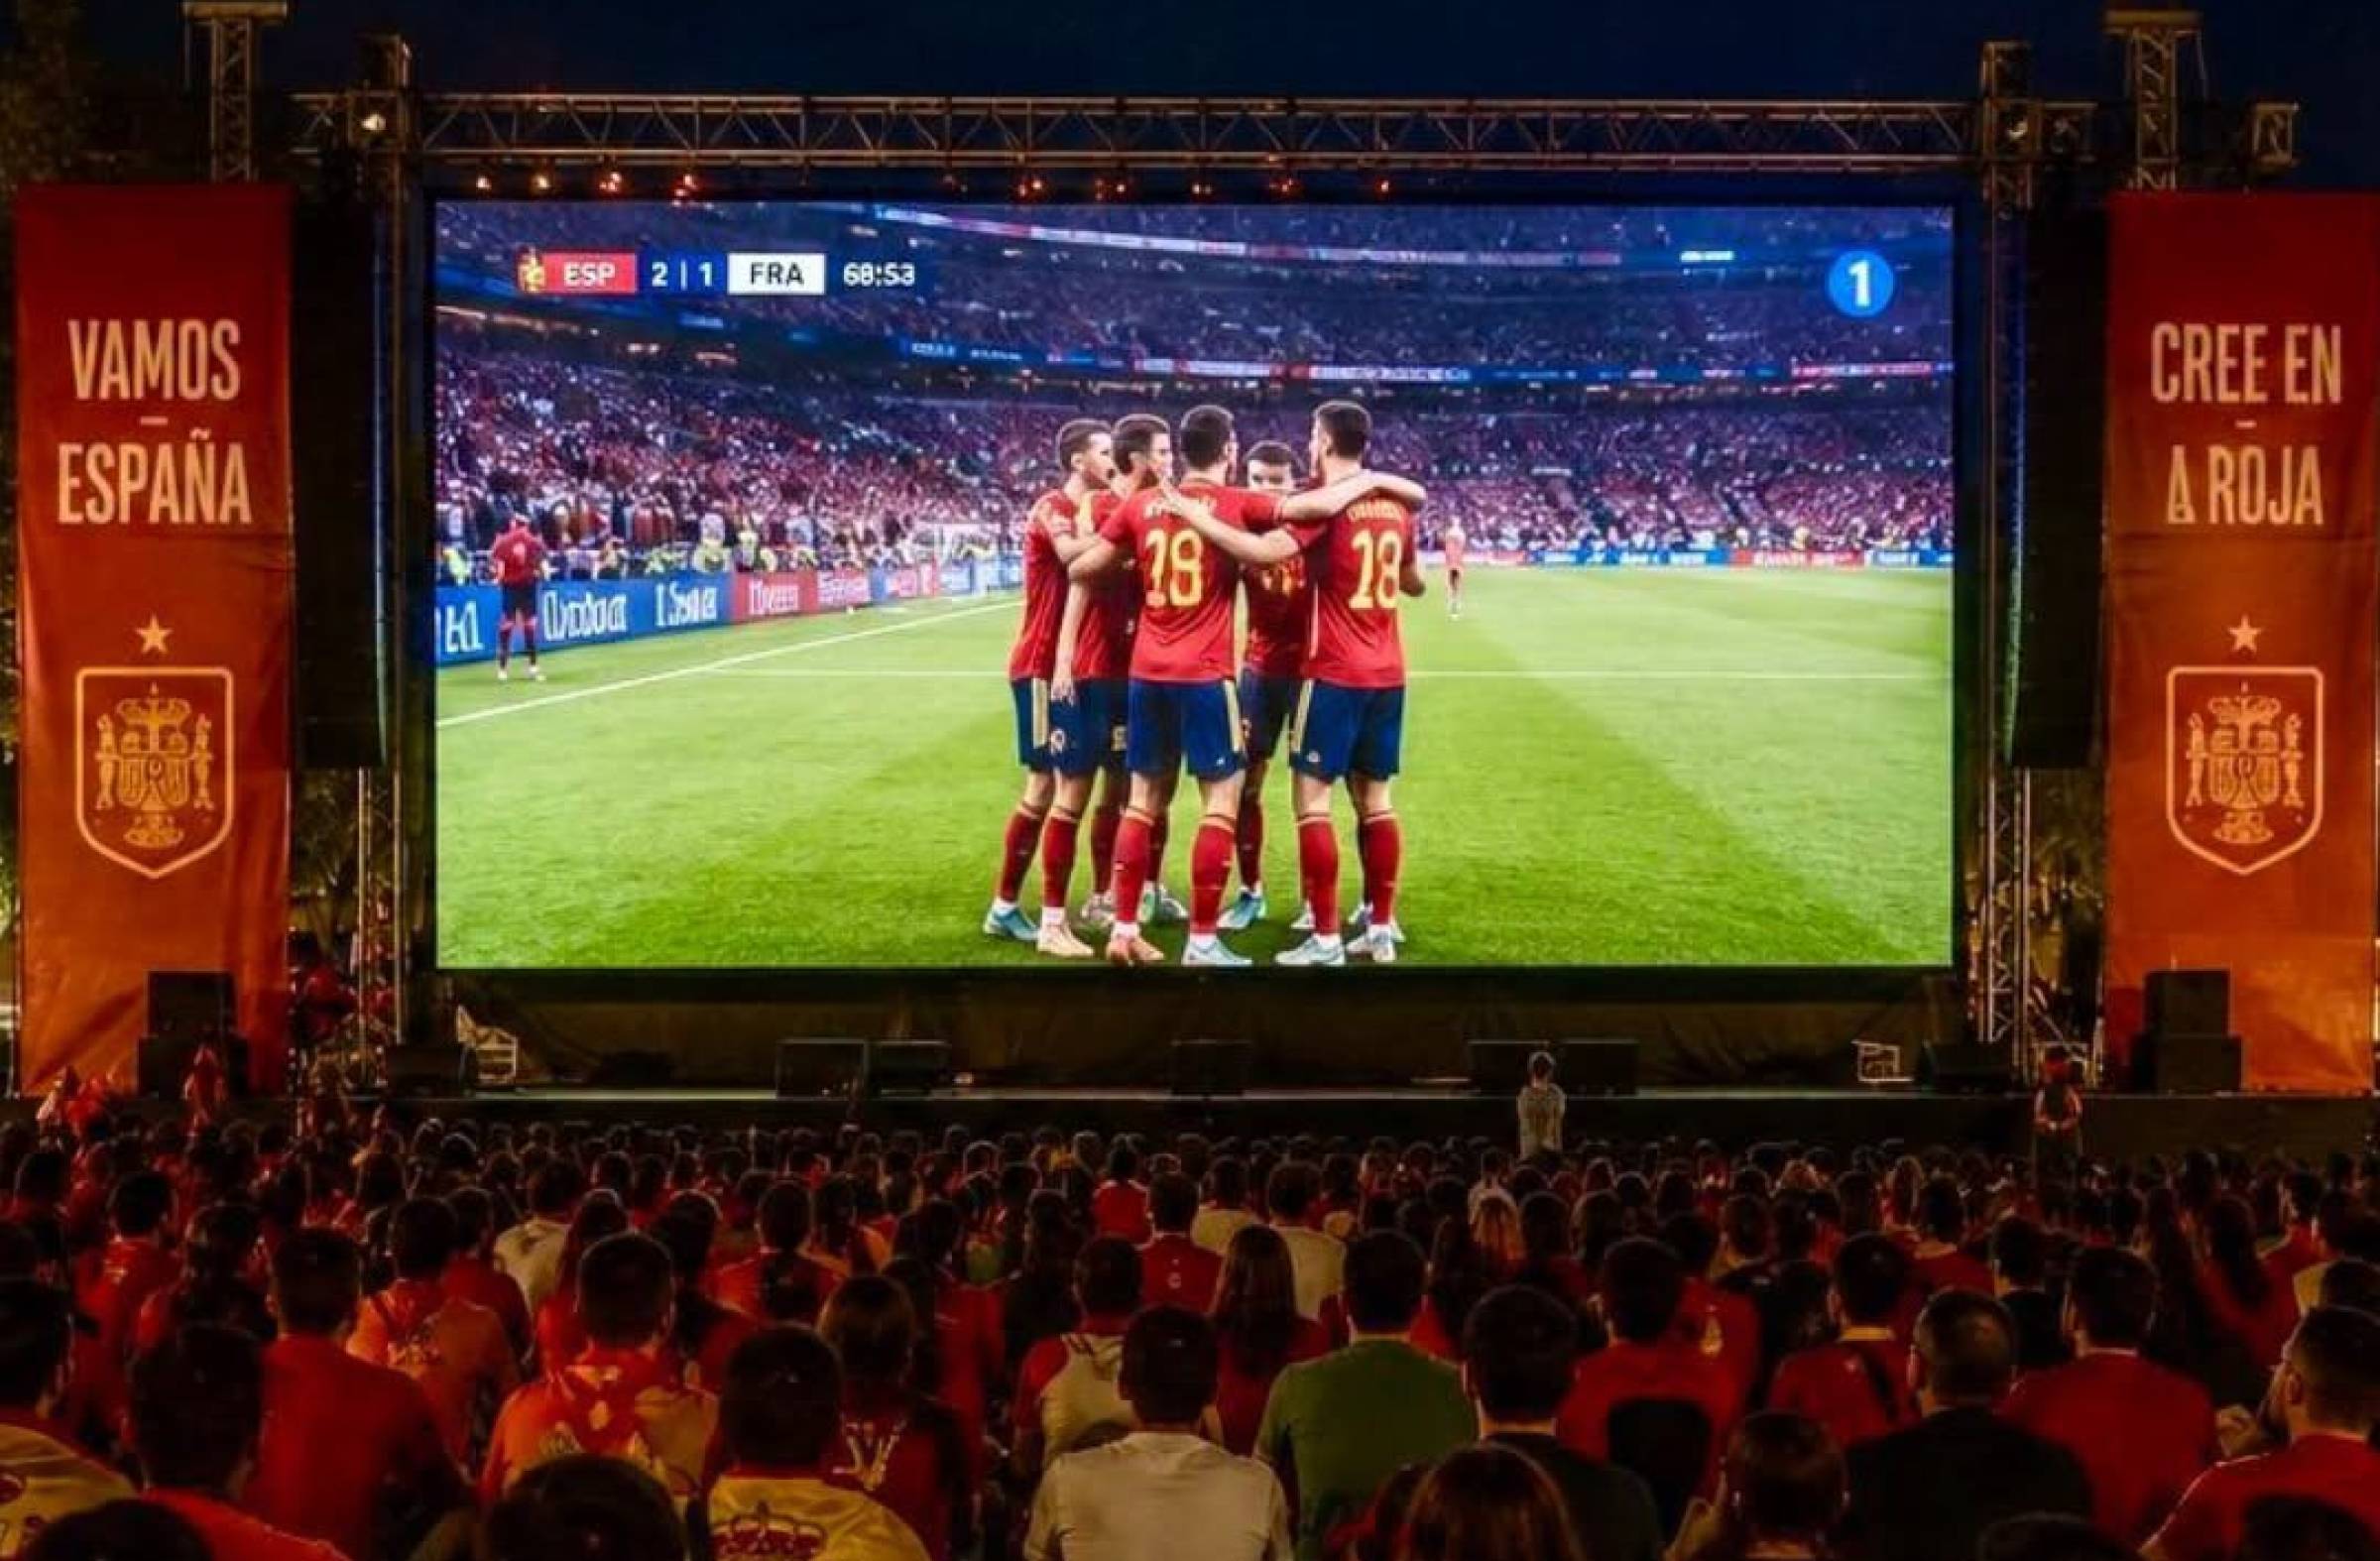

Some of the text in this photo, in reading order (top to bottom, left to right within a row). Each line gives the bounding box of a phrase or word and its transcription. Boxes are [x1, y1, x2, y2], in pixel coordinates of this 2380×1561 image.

[564, 261, 616, 288] ESP
[652, 261, 668, 288] 2
[750, 261, 805, 287] FRA
[1848, 260, 1871, 307] 1
[68, 318, 241, 401] VAMOS
[2150, 321, 2341, 404] CREE EN
[58, 428, 252, 524] ESPAÑA
[2207, 443, 2324, 525] ROJA
[1349, 530, 1401, 609] 18
